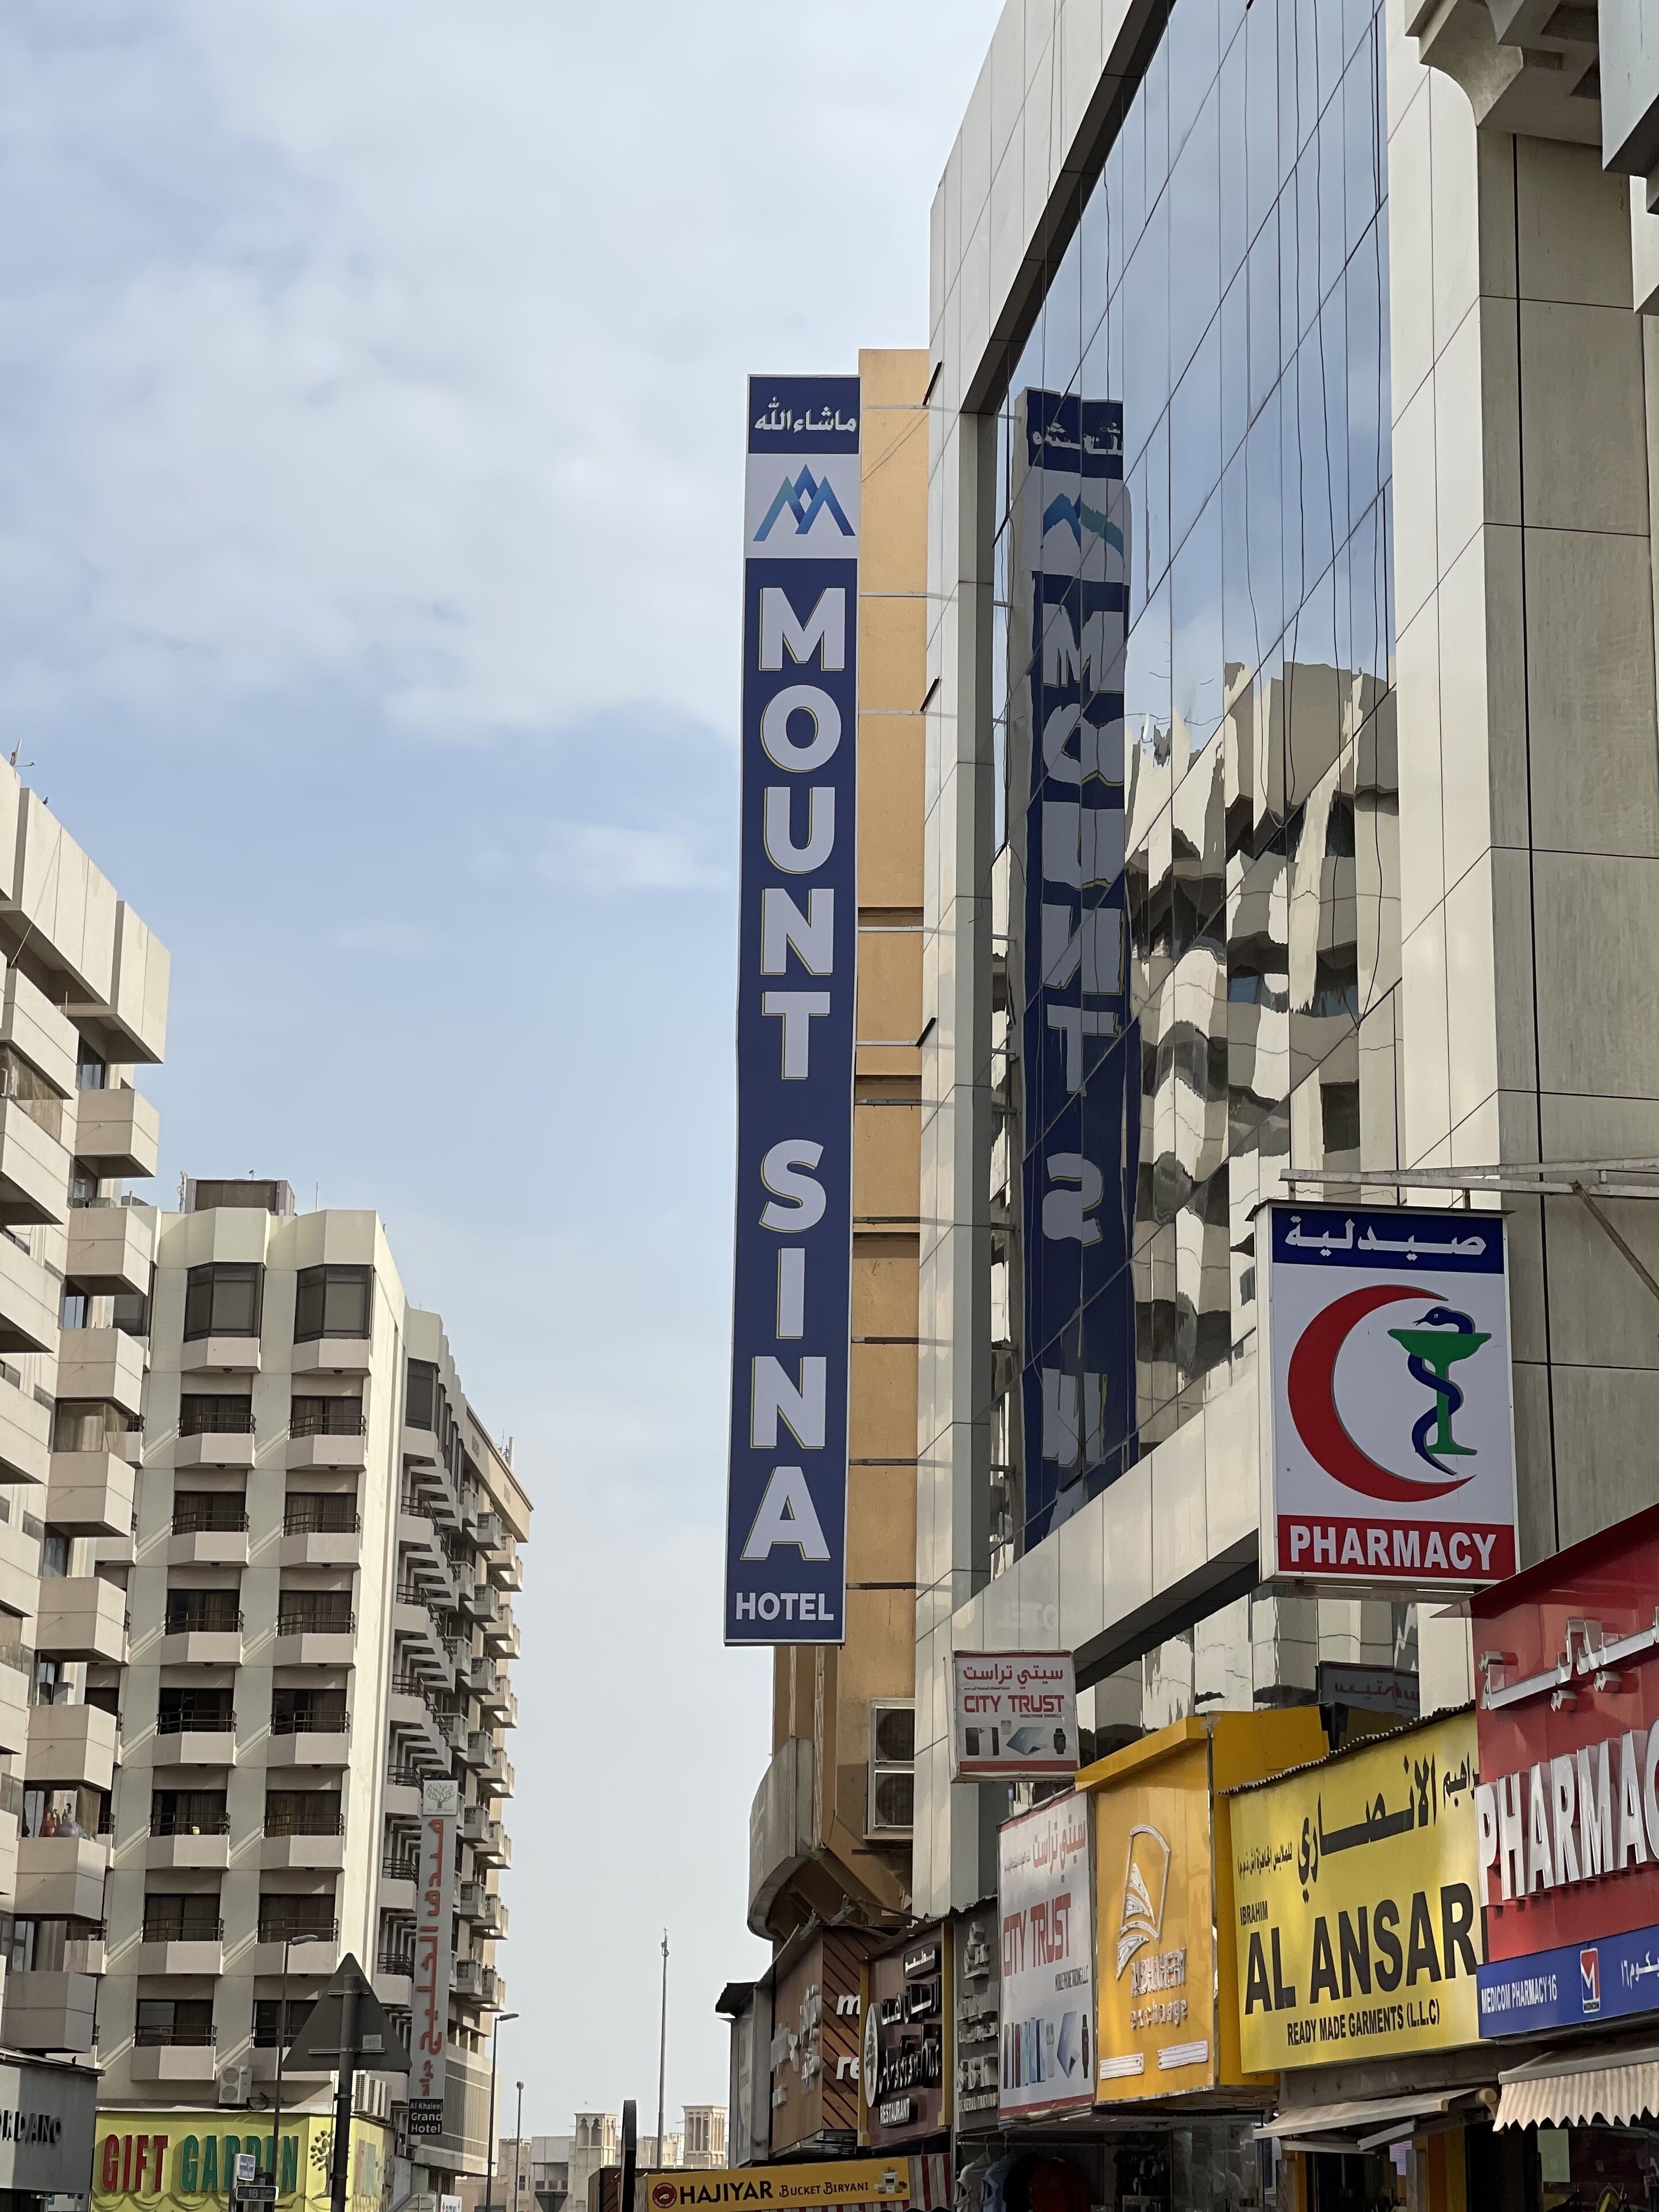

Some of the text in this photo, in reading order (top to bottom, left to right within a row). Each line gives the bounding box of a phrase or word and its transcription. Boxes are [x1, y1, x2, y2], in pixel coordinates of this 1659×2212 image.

[740, 588, 846, 1561] MOUNT SINA
[1285, 1215, 1486, 1261] صيدلية
[1290, 1525, 1497, 1571] PHARMACY
[736, 1592, 834, 1621] HOTEL
[963, 1663, 1063, 1690] سيتي تراست
[1478, 1605, 1659, 1712] يدلية
[964, 1695, 1065, 1713] CITY TRUST
[1443, 1751, 1479, 1811] راهيم
[1033, 1814, 1086, 1884] سيتي تراست
[1240, 1900, 1268, 1926] IBRAHIM
[1003, 1892, 1071, 1978] CITY TRUST
[1245, 1927, 1296, 2016] AL
[1482, 1974, 1558, 2014] MEDICOM PHARMACY 16
[1287, 2019, 1317, 2046] READY
[1319, 2014, 1346, 2041] MADE
[1348, 2004, 1404, 2037] GARMENTS
[411, 2112, 442, 2121] Grand
[418, 2102, 442, 2111] Khaleej
[880, 2097, 910, 2125] RESTAURANT
[0, 2109, 62, 2145] RDANO
[411, 2124, 441, 2133] Hotel
[102, 2134, 169, 2192] GIFT
[248, 2188, 258, 2199] 18
[680, 2180, 774, 2205] HAJIYAR
